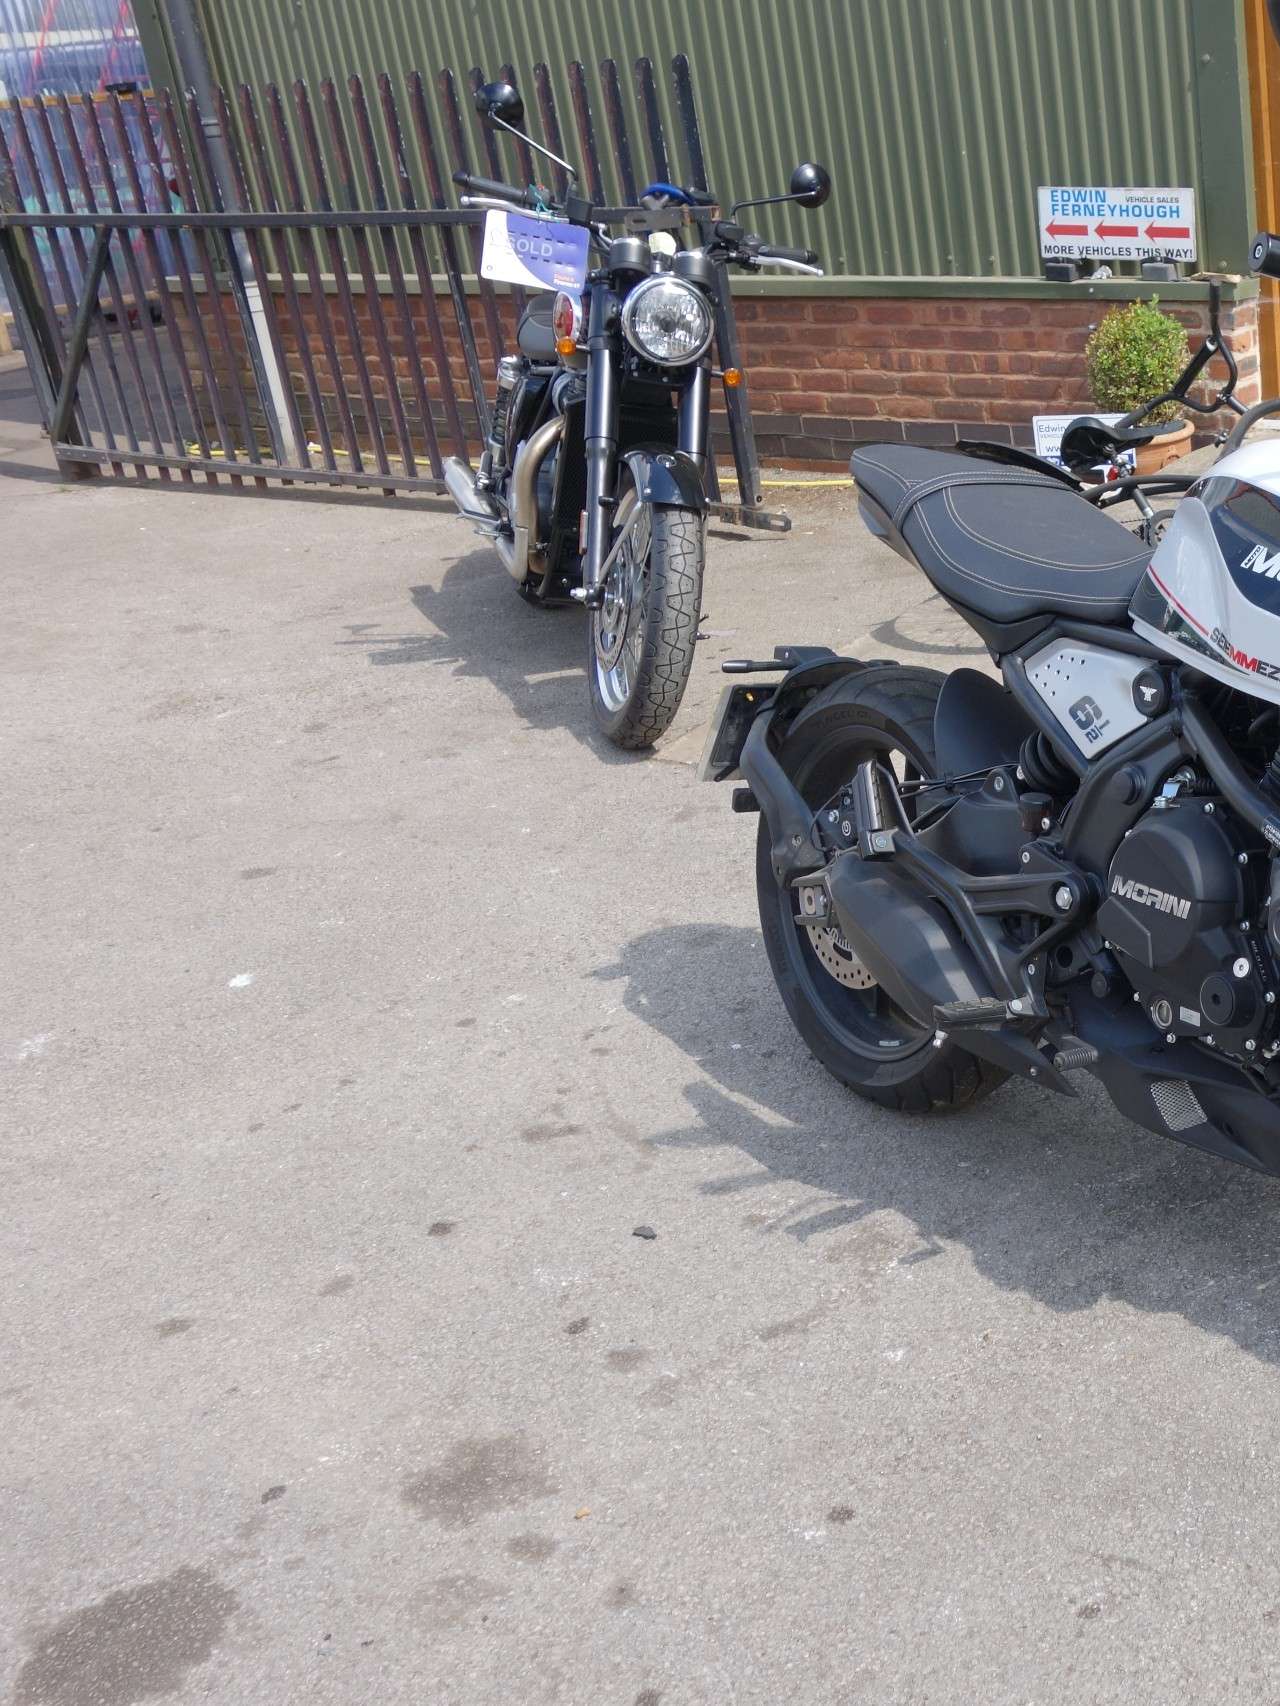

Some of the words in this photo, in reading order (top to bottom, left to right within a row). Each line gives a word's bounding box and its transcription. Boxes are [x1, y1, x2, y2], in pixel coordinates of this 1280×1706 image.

[1050, 189, 1106, 204] EDWIN
[1125, 196, 1154, 204] VEHICLE
[1156, 196, 1180, 204] SALES
[1051, 203, 1181, 219] FERNEYHOUGH
[1044, 245, 1074, 256] MORE
[1077, 245, 1132, 257] VEHICLES
[1135, 247, 1161, 258] THIS
[1165, 248, 1193, 259] WAY!
[1111, 874, 1192, 920] MORINI
